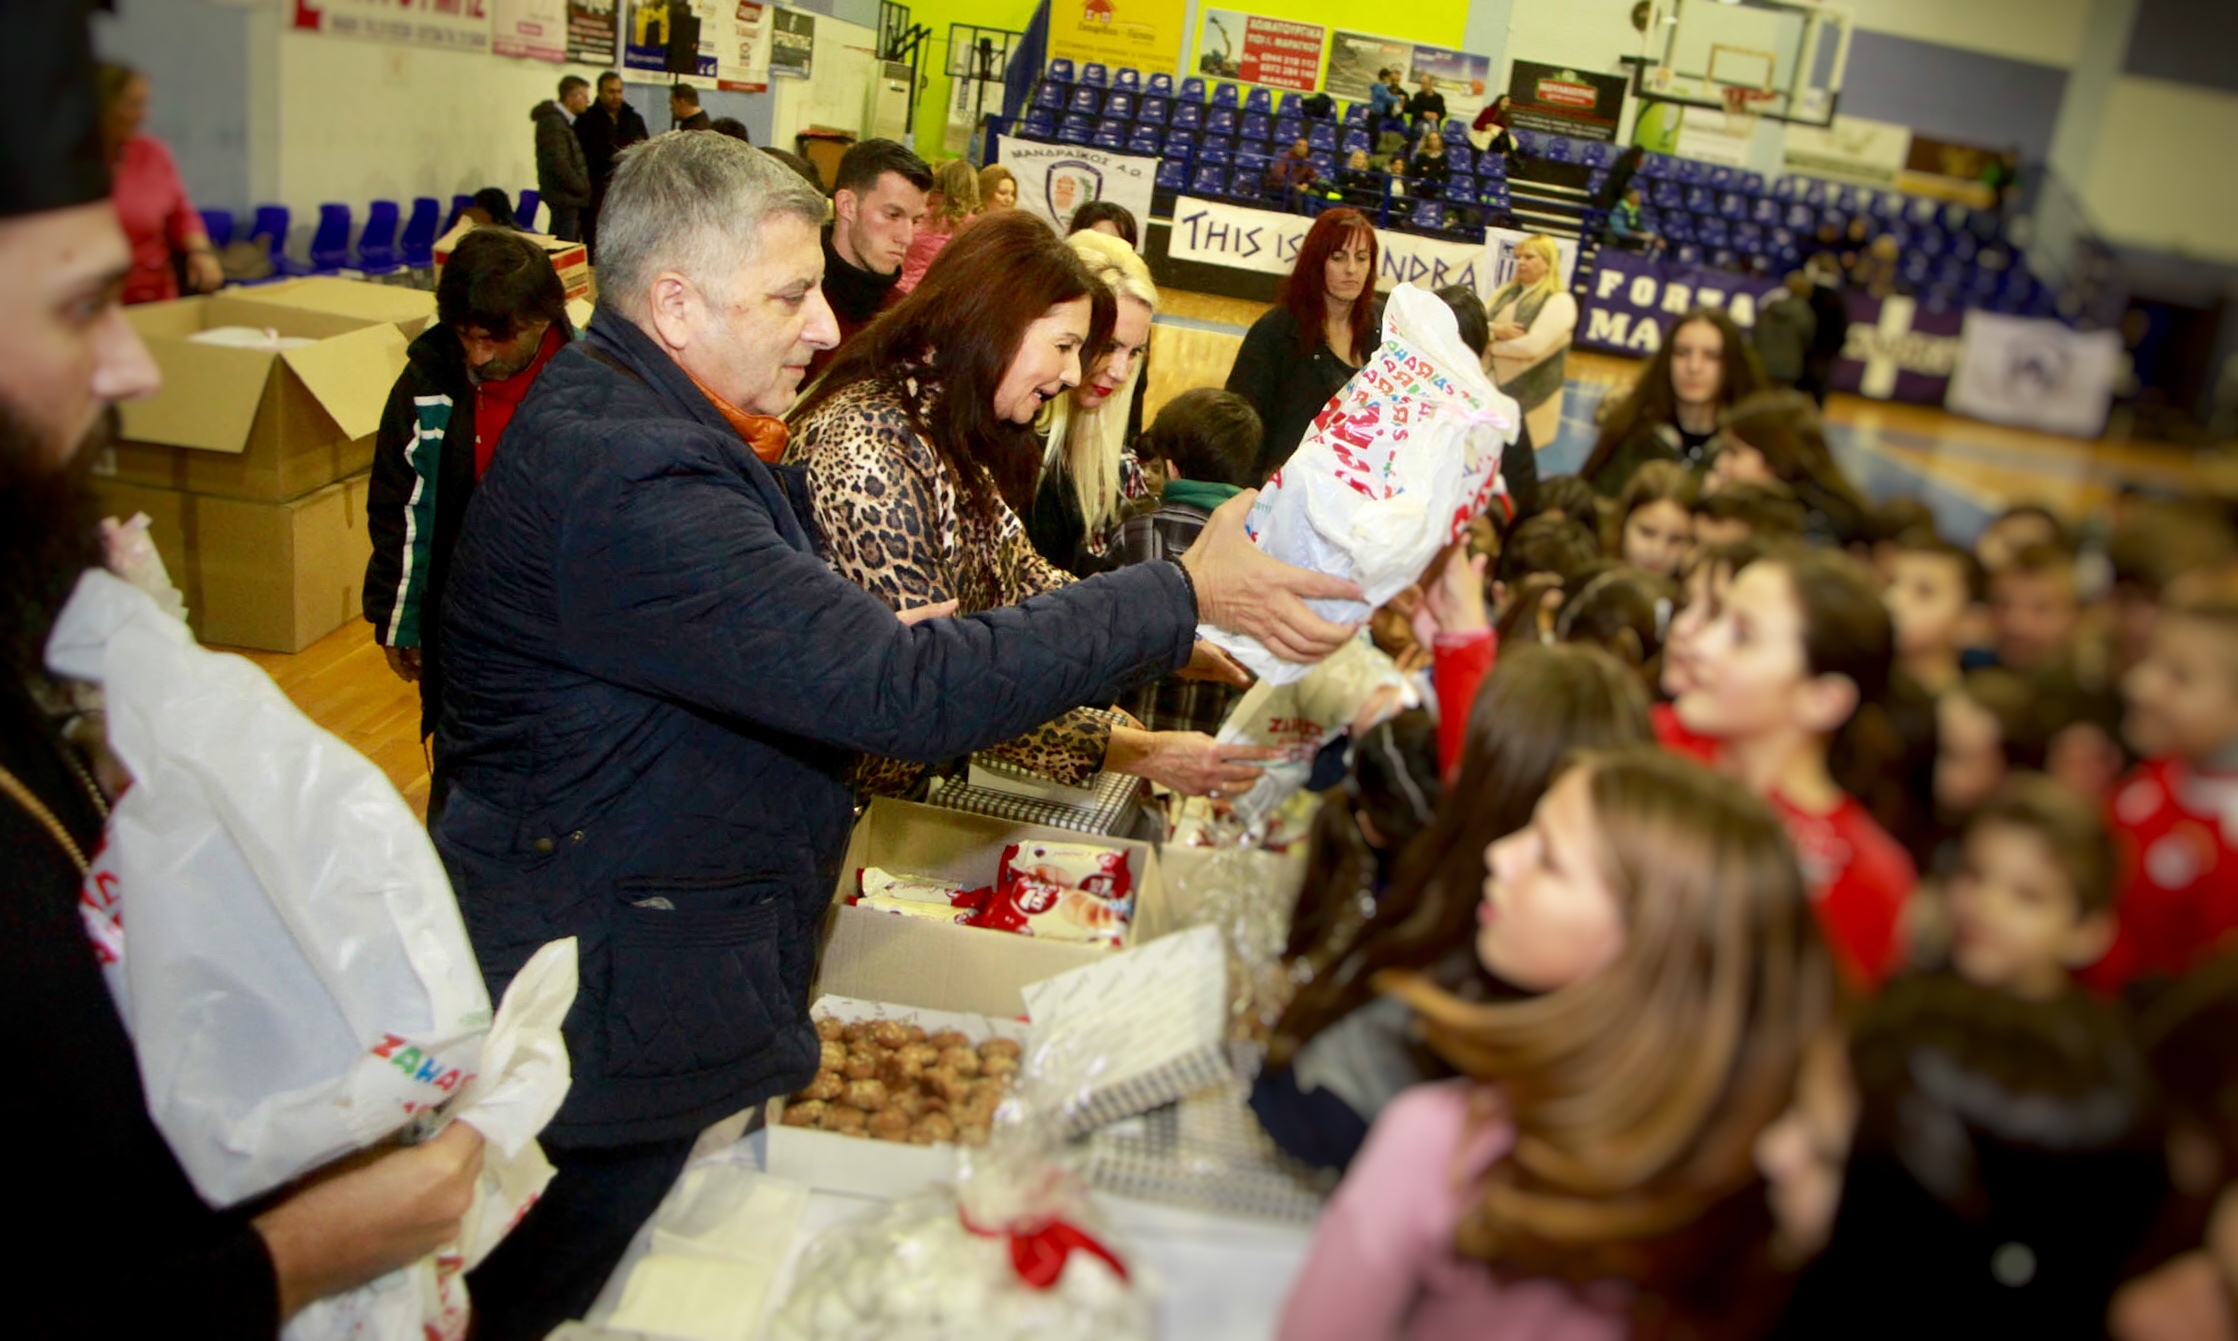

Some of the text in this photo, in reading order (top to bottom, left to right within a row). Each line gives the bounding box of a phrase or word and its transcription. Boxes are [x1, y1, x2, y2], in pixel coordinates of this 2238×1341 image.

[1182, 210, 1477, 292] THIS IS NDRA
[1586, 307, 1662, 353] MA
